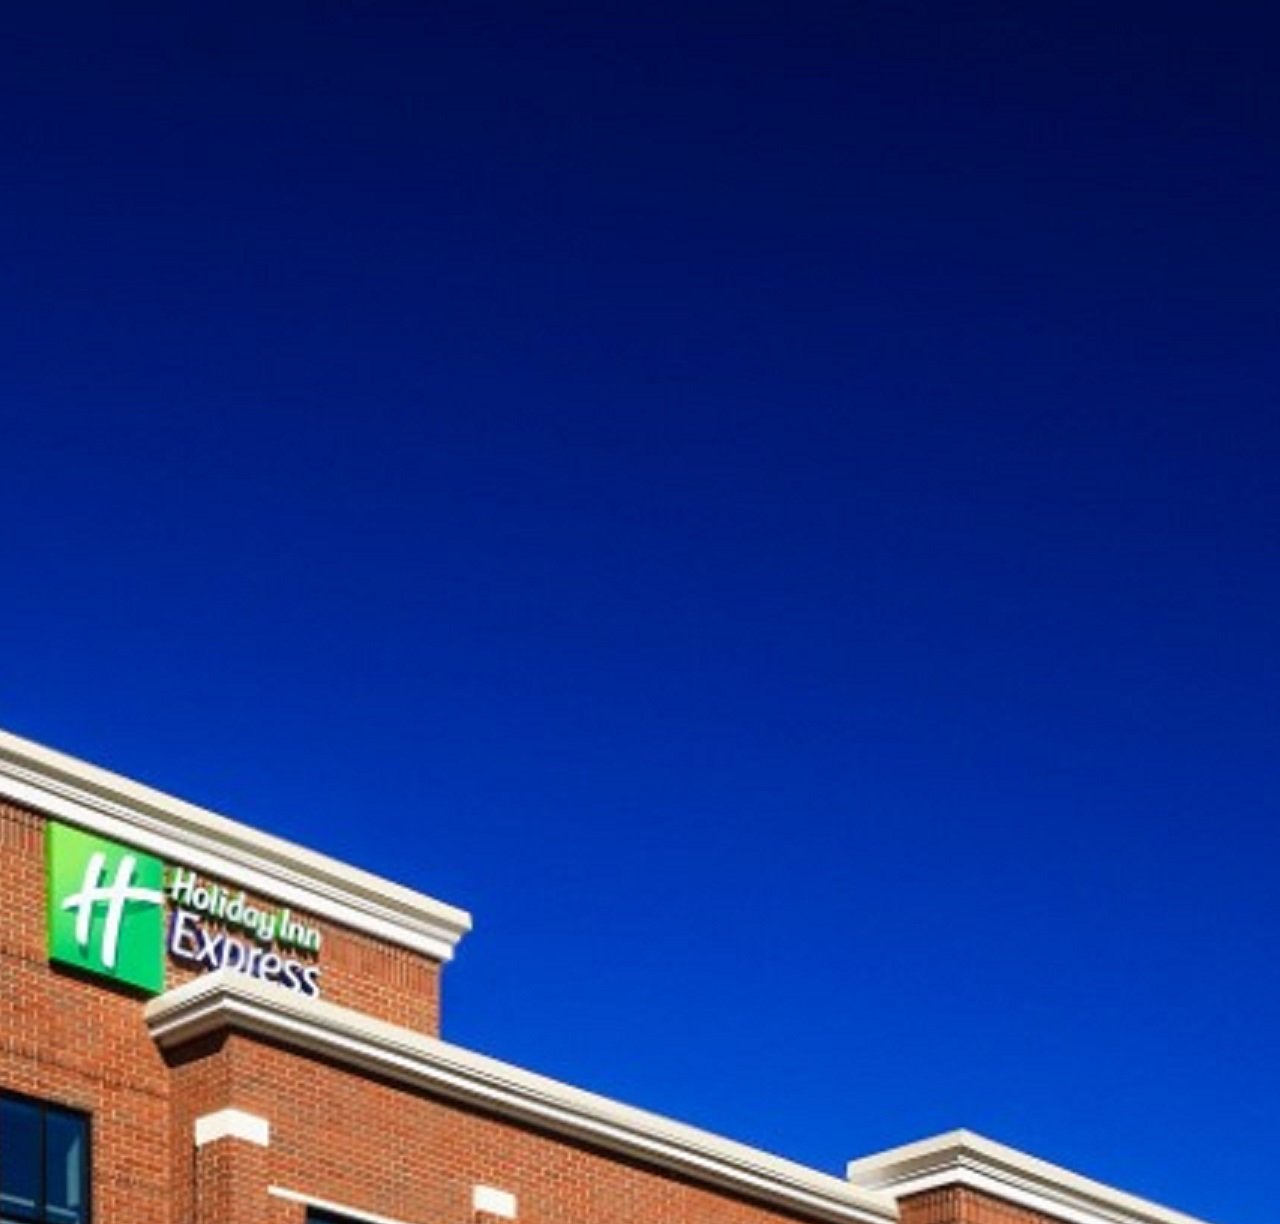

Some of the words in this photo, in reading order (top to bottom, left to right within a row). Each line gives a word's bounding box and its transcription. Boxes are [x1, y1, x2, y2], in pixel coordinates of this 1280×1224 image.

[170, 866, 274, 940] Holiday
[278, 908, 321, 951] Inn
[171, 910, 321, 999] Express
